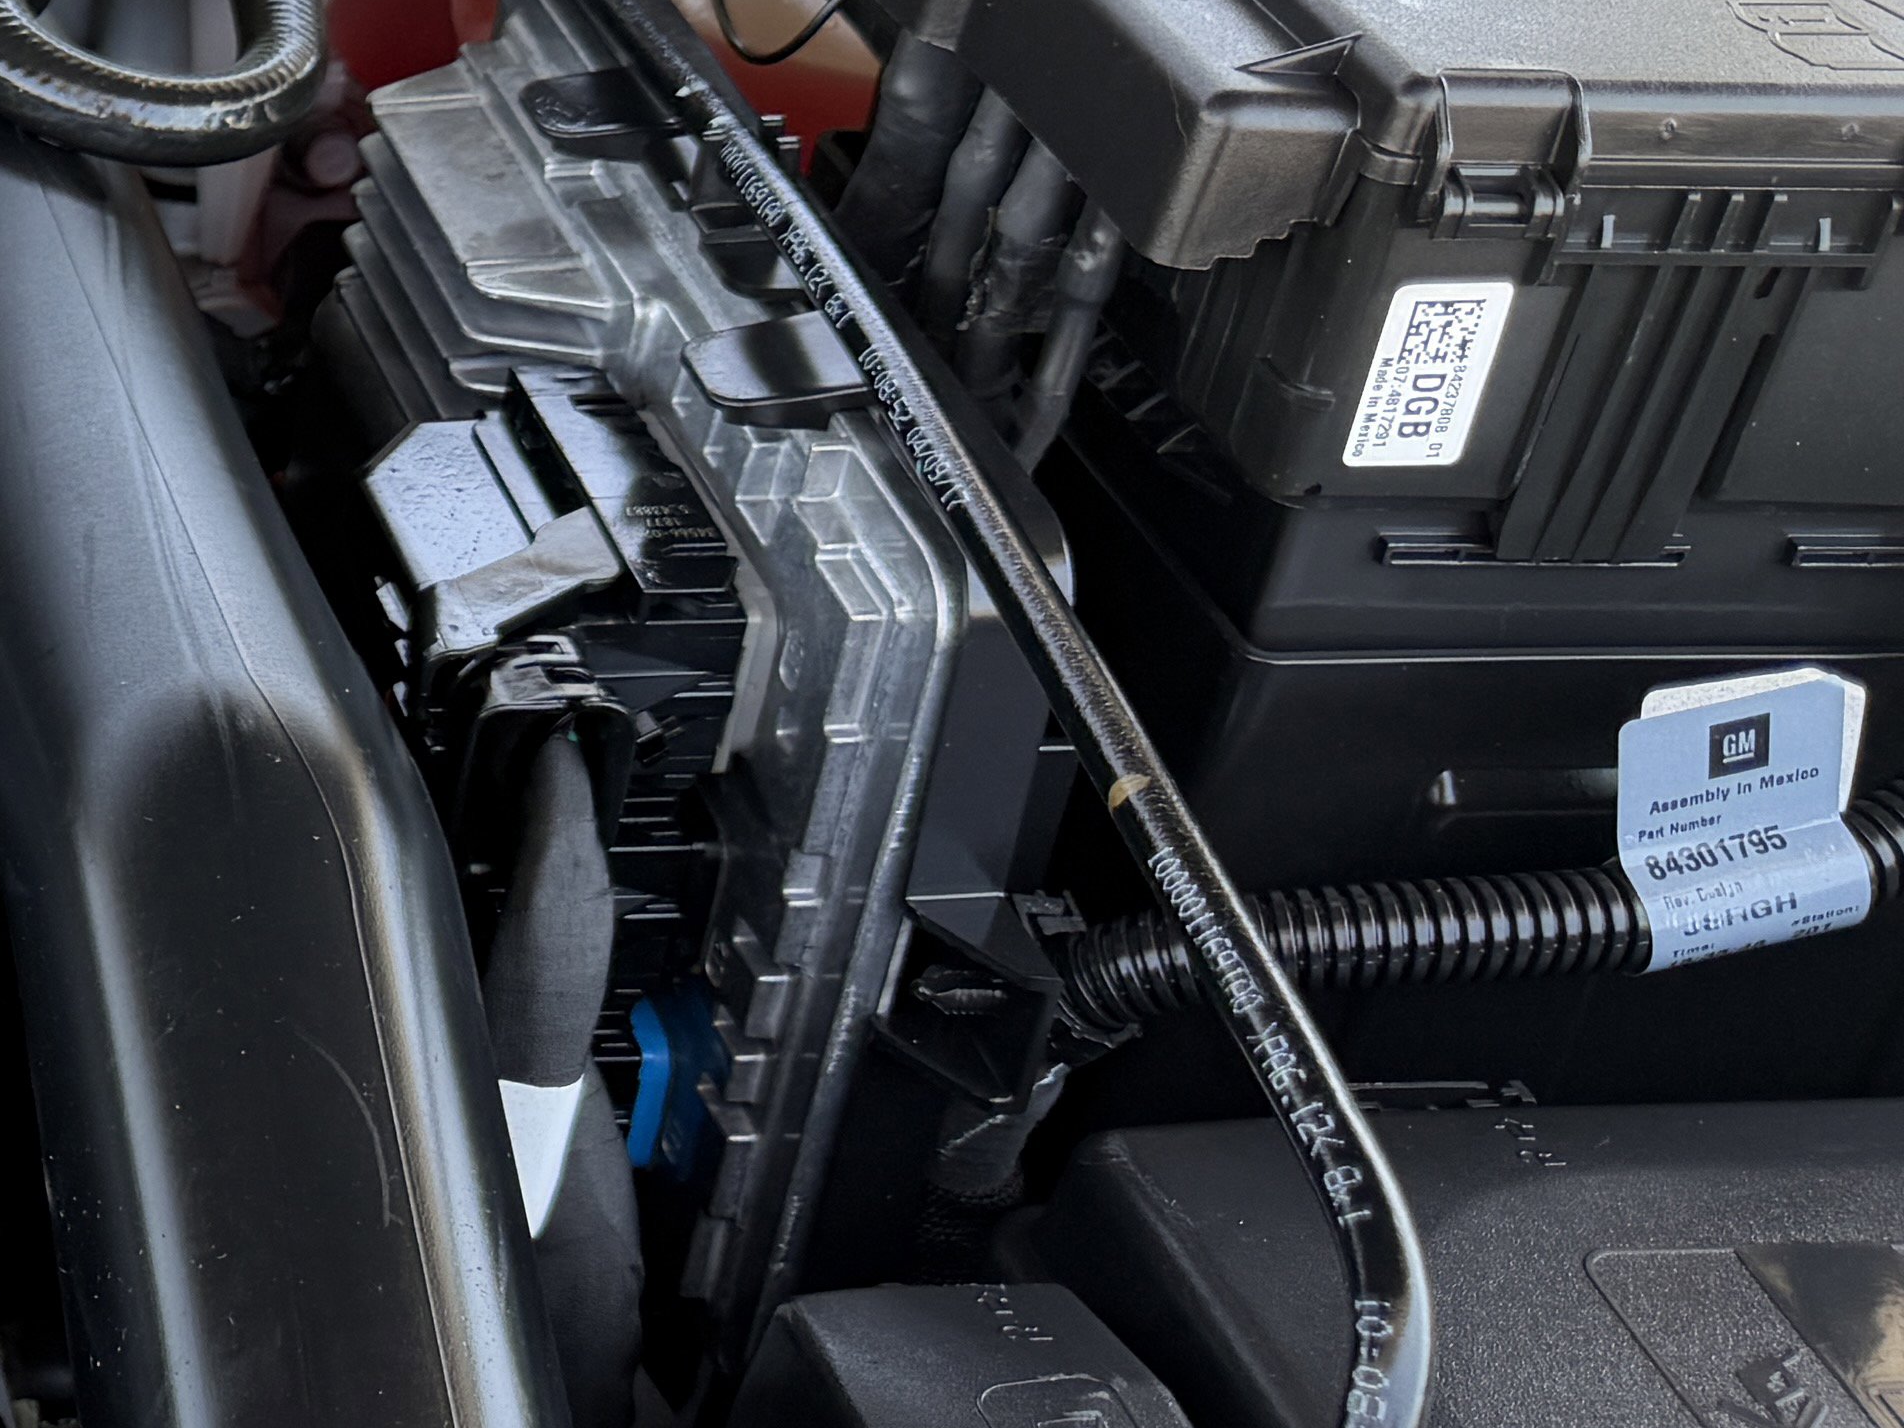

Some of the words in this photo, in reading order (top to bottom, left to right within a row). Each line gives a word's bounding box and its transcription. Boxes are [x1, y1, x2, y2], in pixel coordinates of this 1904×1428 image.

[1374, 357, 1395, 393] Made
[1434, 364, 1468, 434] 84237808
[1397, 372, 1448, 439] DGB
[1351, 412, 1378, 458] Mexico
[1721, 727, 1756, 759] GM
[1648, 783, 1730, 815] Assembly
[1758, 765, 1819, 790] Mexico
[1637, 824, 1665, 843] Part
[1669, 813, 1722, 836] Number
[1645, 825, 1788, 881] 84301795
